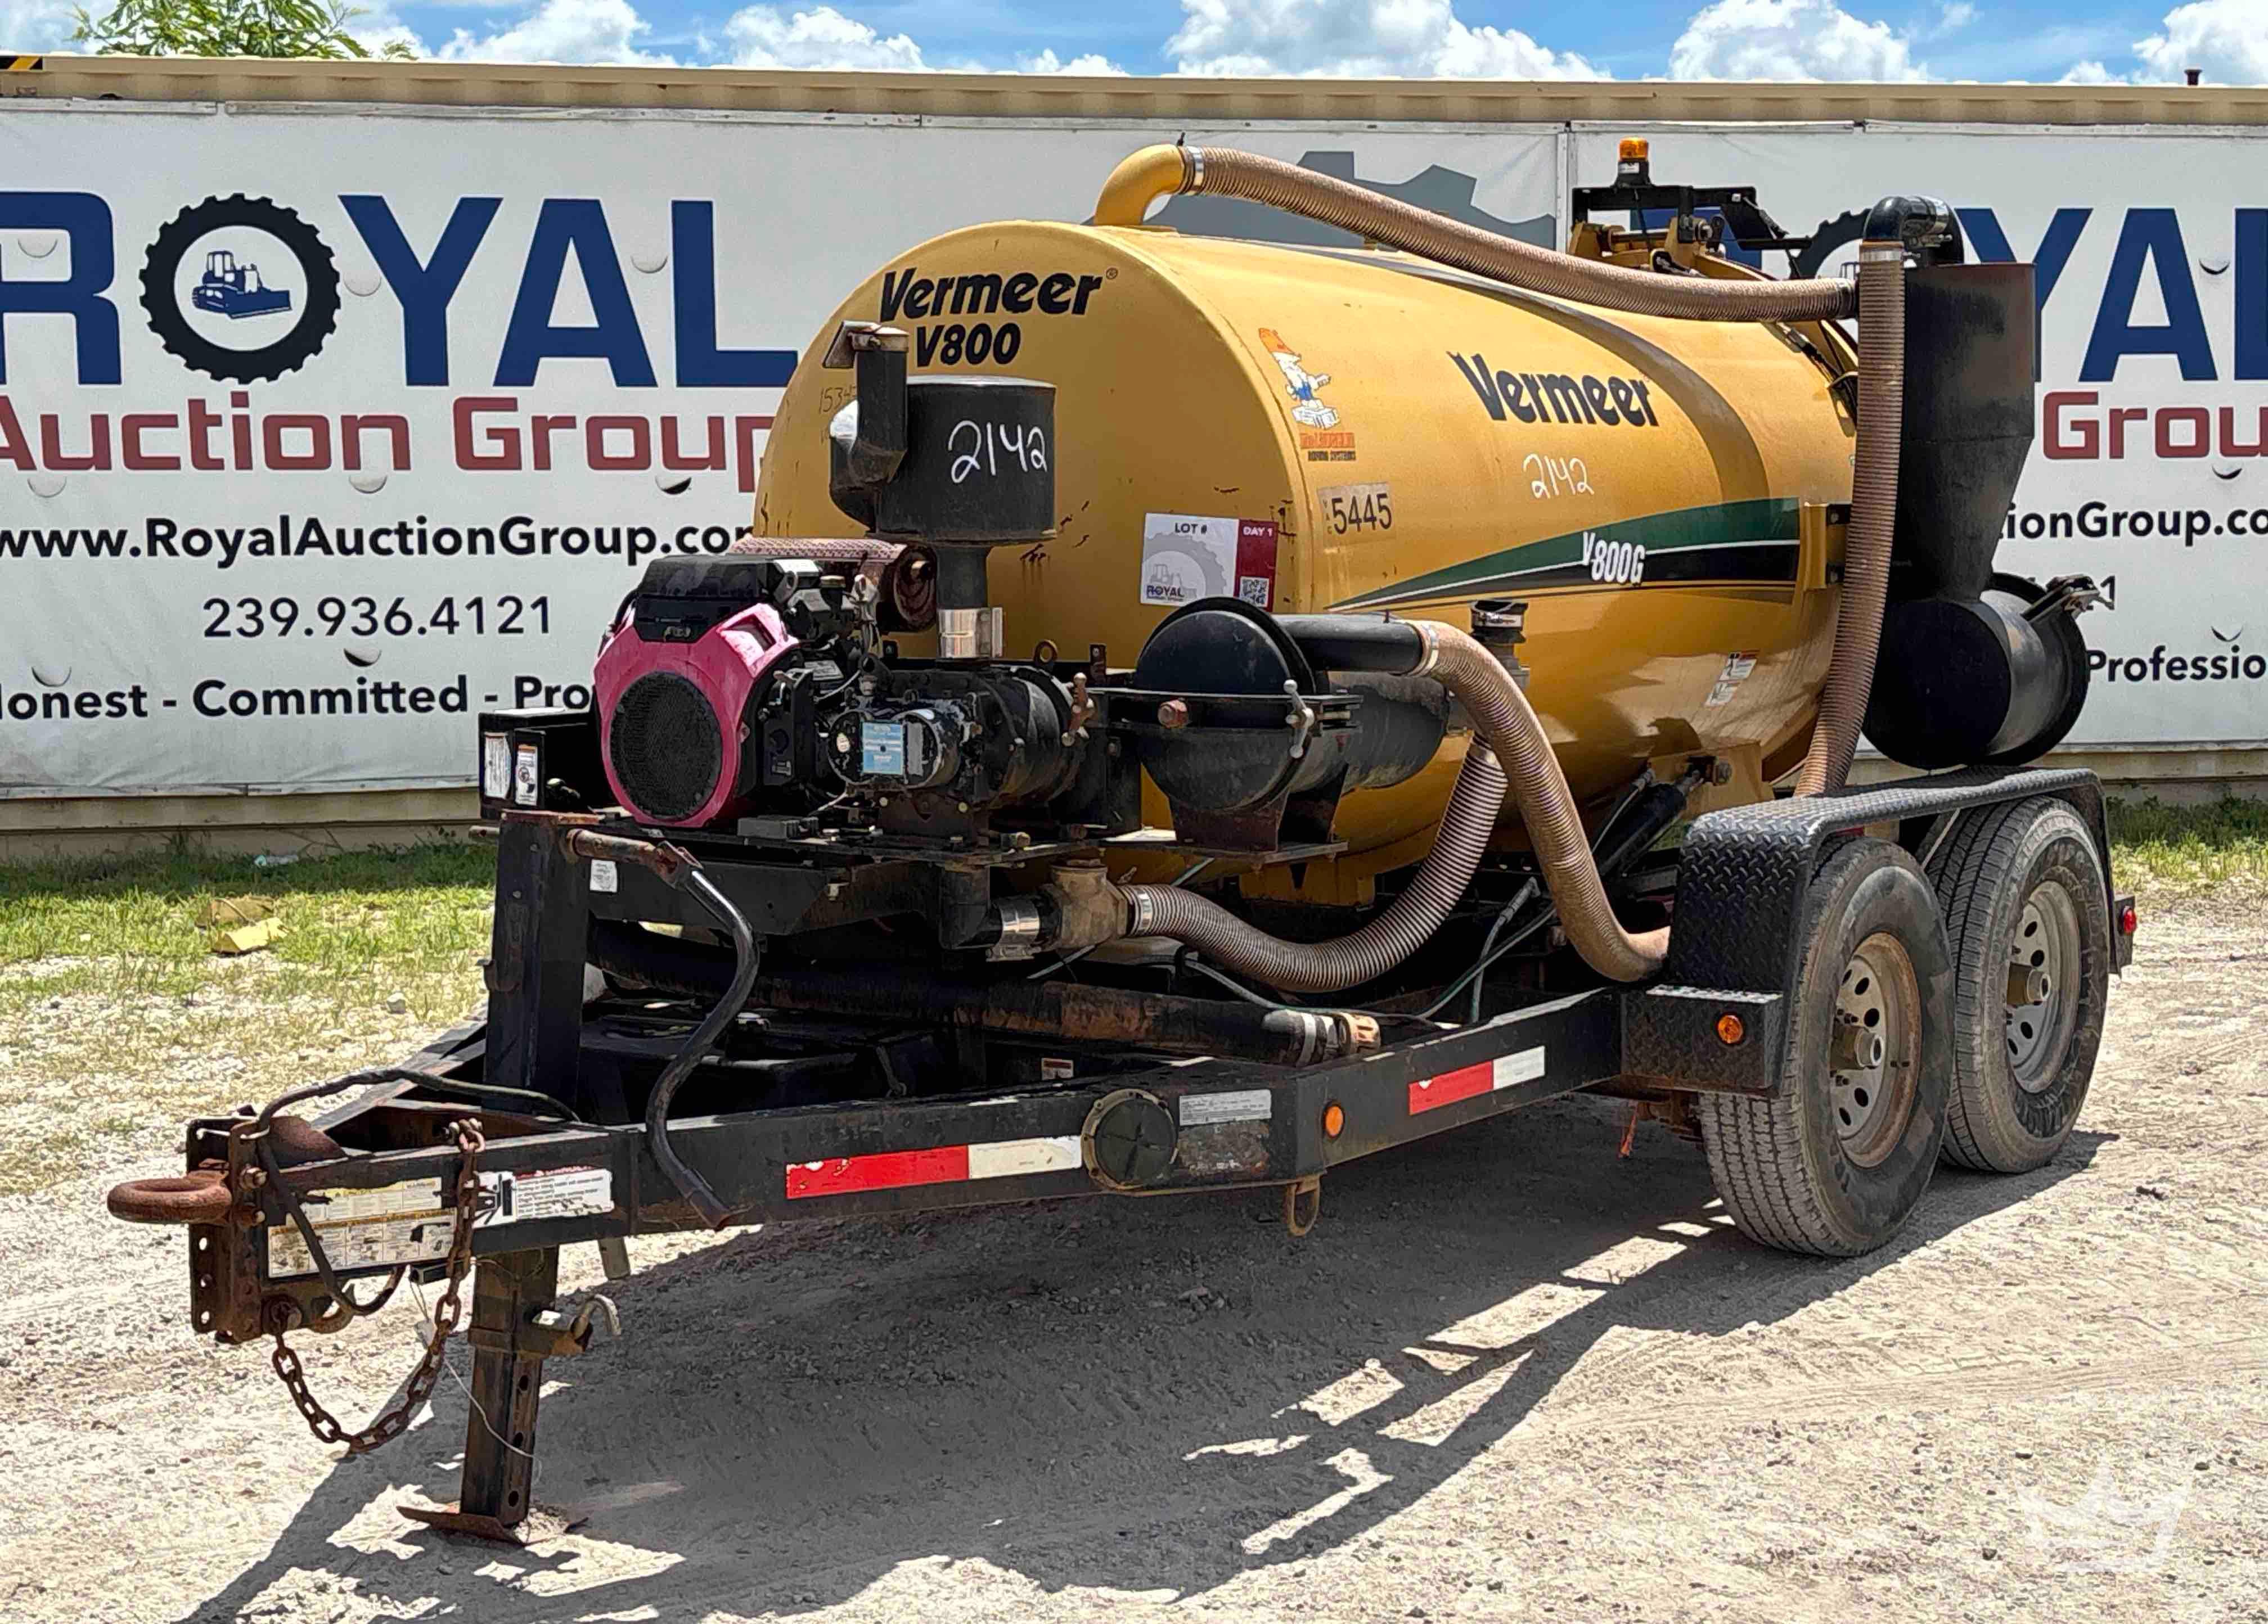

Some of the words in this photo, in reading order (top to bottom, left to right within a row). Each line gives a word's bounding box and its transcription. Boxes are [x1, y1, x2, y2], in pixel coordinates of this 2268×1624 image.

[916, 322, 1021, 367] V800
[1447, 351, 1658, 427] Vermeer
[948, 420, 1047, 483] 2142
[1523, 454, 1595, 498] 2142
[1175, 522, 1198, 533] LOT
[1243, 526, 1265, 536] DAY
[1267, 528, 1273, 536] 1
[1331, 493, 1392, 534] 5445
[1146, 585, 1184, 597] ROYAL
[203, 596, 549, 637] 239.936.4121
[0, 683, 147, 719] onest
[193, 675, 467, 717] Committed
